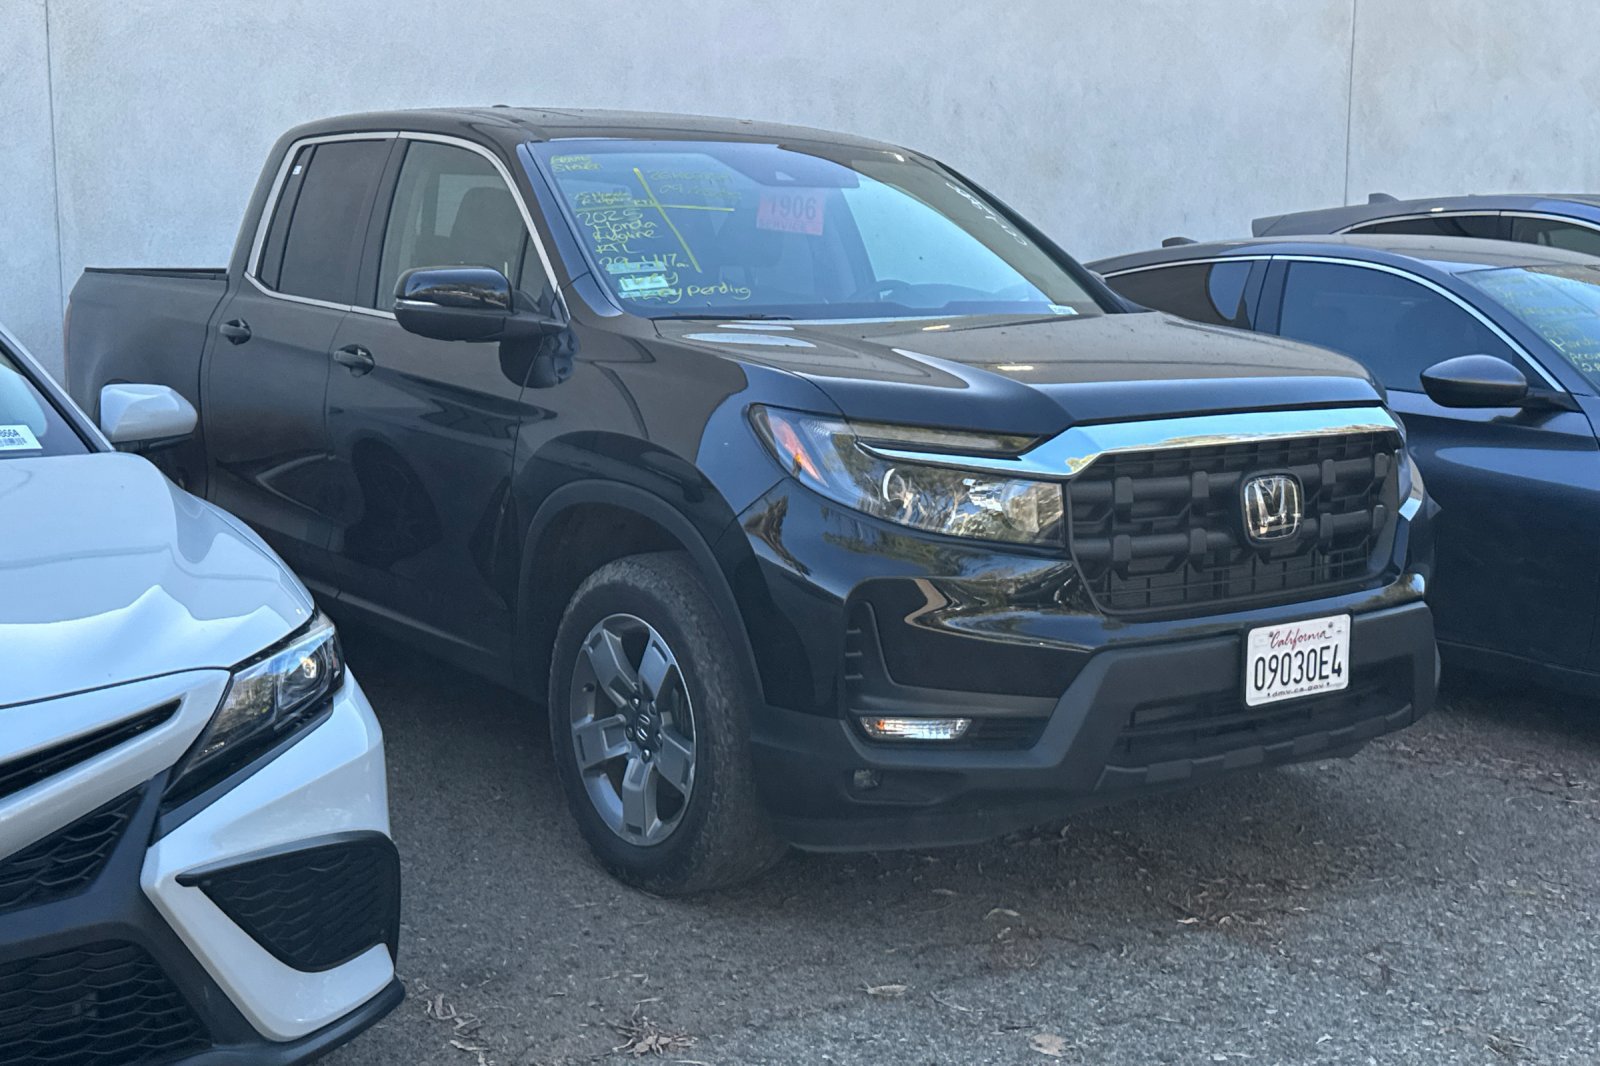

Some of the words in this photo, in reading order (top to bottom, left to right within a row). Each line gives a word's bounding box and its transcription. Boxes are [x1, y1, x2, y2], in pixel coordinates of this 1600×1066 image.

[576, 208, 643, 226] 2025
[769, 195, 816, 220] 1906
[594, 219, 658, 234] Honda
[1271, 628, 1332, 650] California
[1254, 643, 1342, 691] 09030E4
[1272, 684, 1324, 698] dmv.ca.gov
